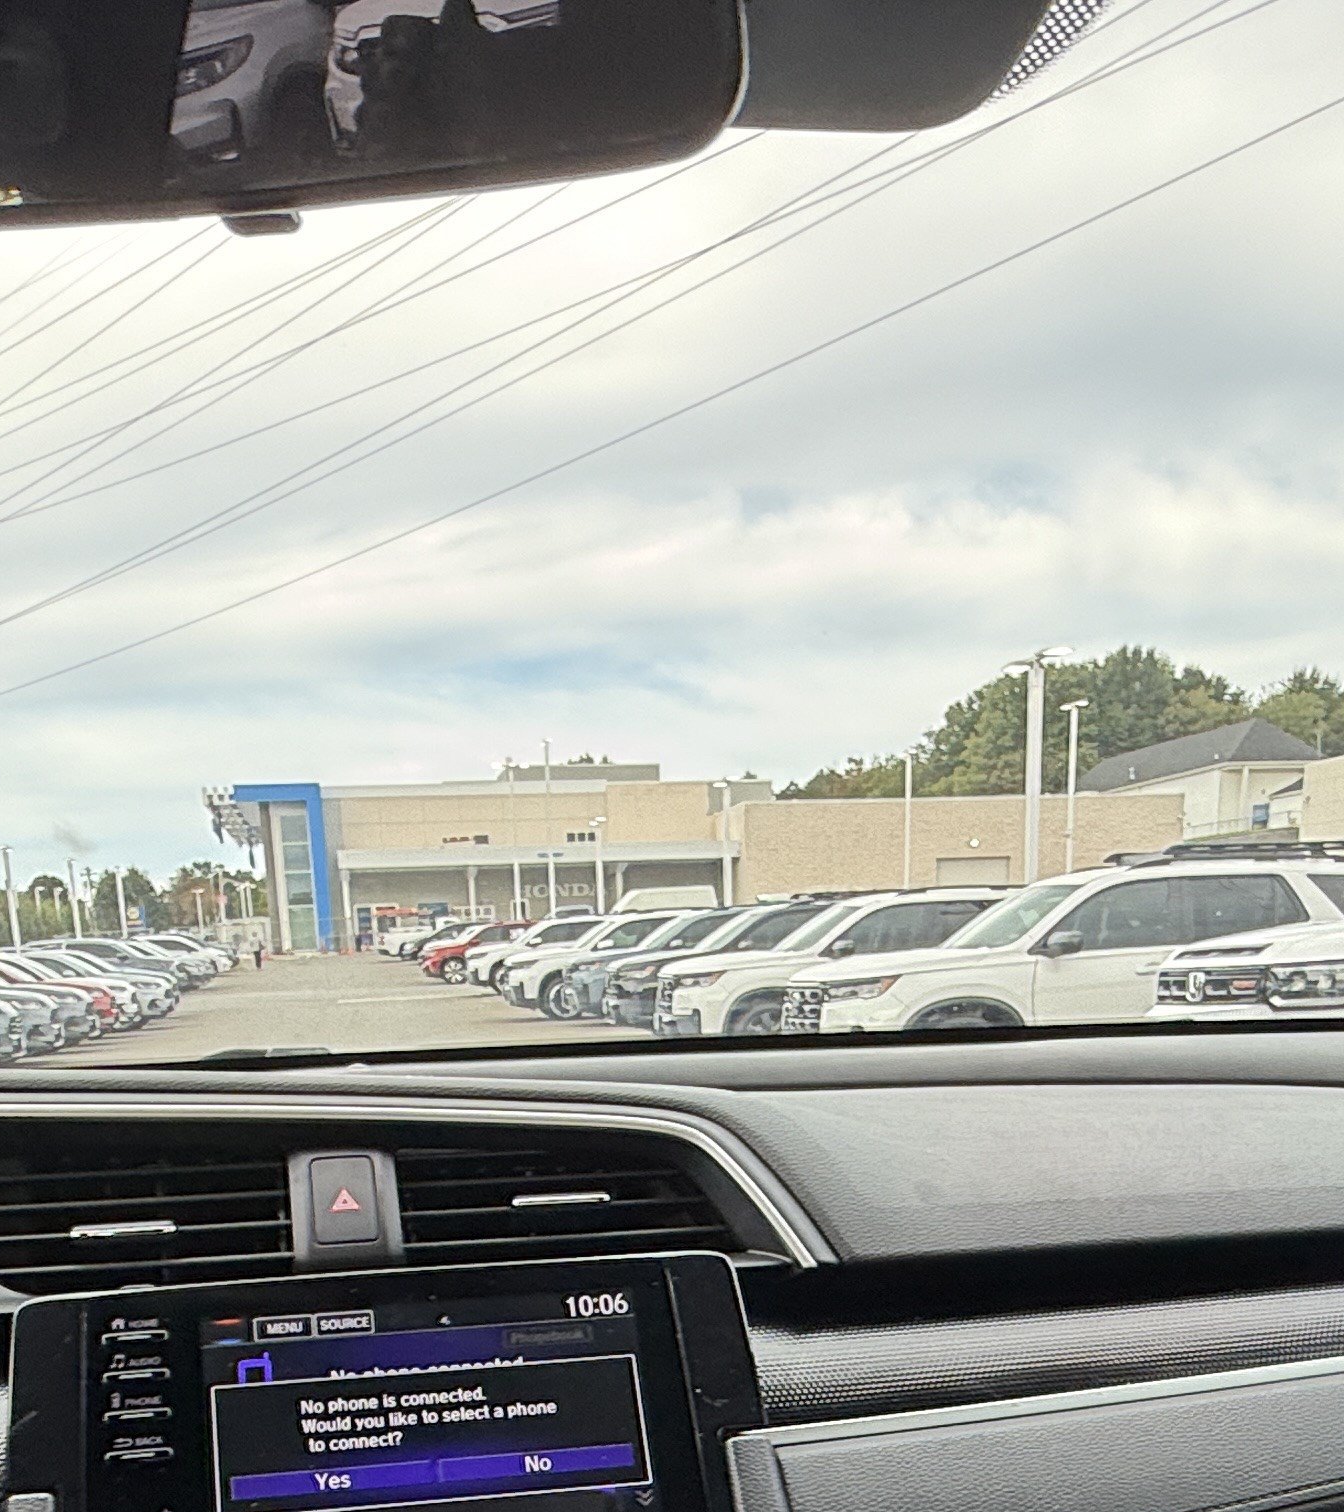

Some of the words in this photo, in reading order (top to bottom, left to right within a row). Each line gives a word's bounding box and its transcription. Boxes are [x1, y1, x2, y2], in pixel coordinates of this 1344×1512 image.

[564, 1292, 629, 1317] 10:06
[266, 1321, 303, 1334] MENU
[319, 1316, 370, 1331] SOURCE
[299, 1400, 325, 1415] No
[328, 1394, 378, 1414] phone
[383, 1394, 396, 1408] is
[400, 1387, 487, 1406] connected.
[301, 1416, 352, 1434] Would
[355, 1415, 385, 1431] you
[389, 1412, 417, 1427] like
[422, 1410, 438, 1424] to
[442, 1404, 490, 1423] select
[493, 1406, 504, 1418] a
[507, 1401, 557, 1419] phone
[309, 1438, 326, 1452] to
[329, 1432, 403, 1451] connect?
[523, 1455, 552, 1473] No
[314, 1473, 351, 1491] Yes
